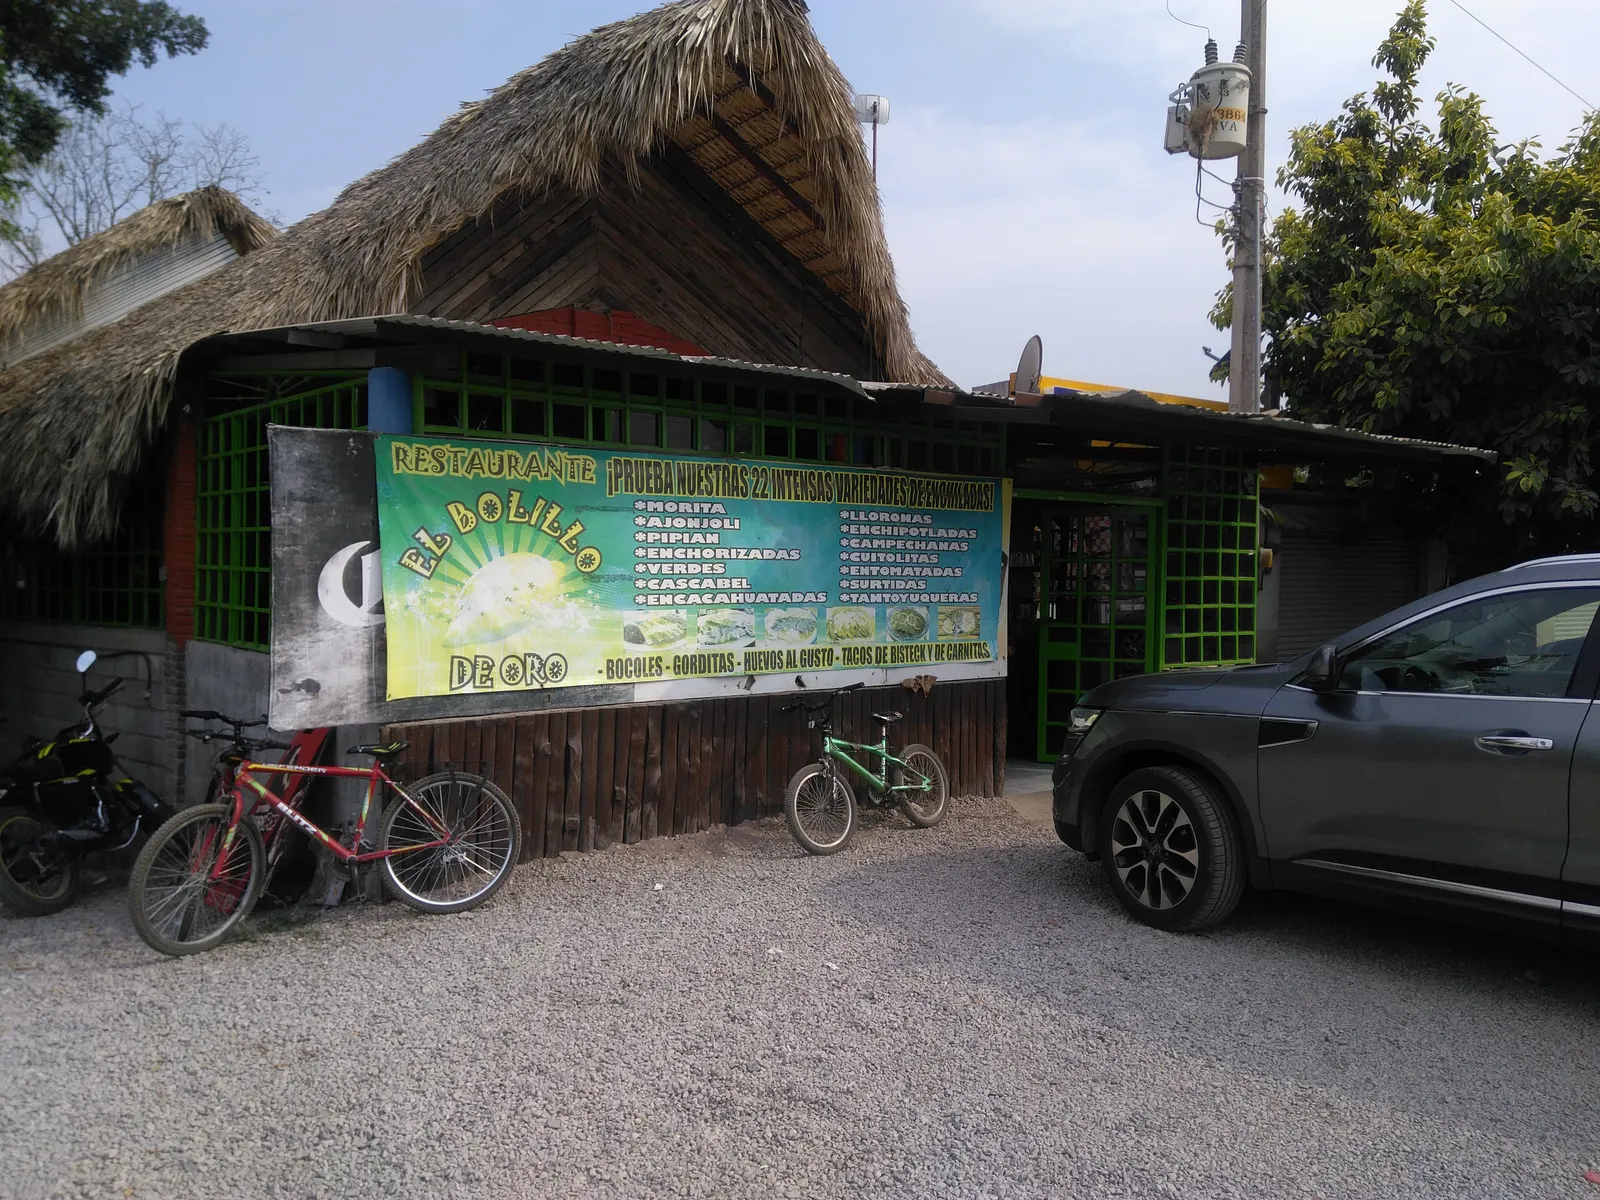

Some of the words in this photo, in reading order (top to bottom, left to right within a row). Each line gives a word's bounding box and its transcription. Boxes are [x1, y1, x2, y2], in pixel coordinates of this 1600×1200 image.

[1214, 120, 1237, 131] VA
[392, 442, 597, 485] RESTAURANTE
[675, 460, 750, 499] NUESTRAS
[751, 465, 769, 500] 22
[771, 467, 834, 504] INTENSAS
[835, 471, 909, 507] VARIEDADES
[909, 477, 925, 508] DE
[925, 479, 994, 512] ENCHILADAS!
[398, 525, 452, 580] EL
[445, 488, 602, 573] BOLILLO
[450, 655, 495, 690] DE
[500, 653, 568, 686] ORO
[606, 656, 662, 680] BOCOLES
[673, 652, 734, 676] GORDITAS
[744, 650, 784, 671] HUEVOS
[786, 649, 798, 668] AL
[800, 648, 833, 668] GUSTO
[841, 646, 872, 665] TACOS
[875, 645, 888, 665] DE
[891, 644, 927, 664] BISTECK
[927, 644, 933, 661] Y
[934, 644, 945, 661] DE
[947, 642, 991, 661] CARNITAS
